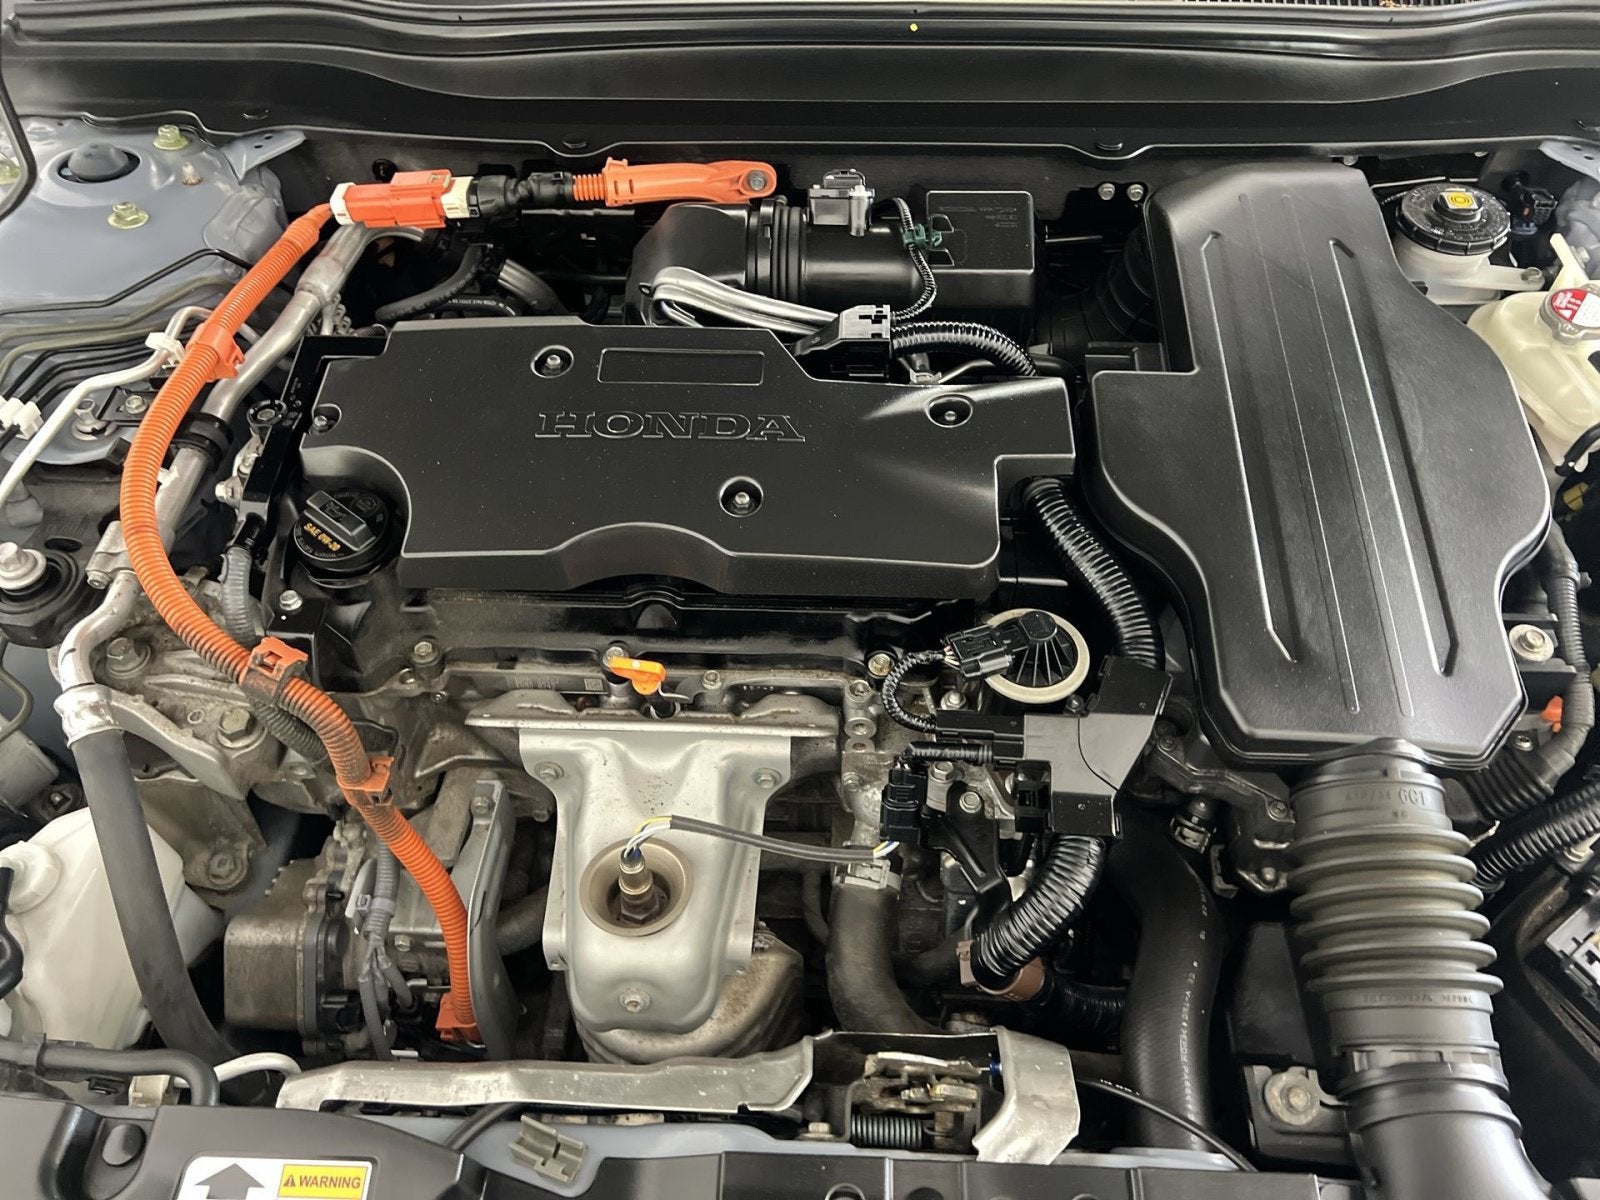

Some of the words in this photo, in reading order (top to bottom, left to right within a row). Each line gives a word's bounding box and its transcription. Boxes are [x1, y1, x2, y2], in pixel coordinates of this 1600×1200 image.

[535, 411, 805, 442] HONDA
[303, 523, 322, 537] SAE
[299, 1175, 361, 1189] WARNING
